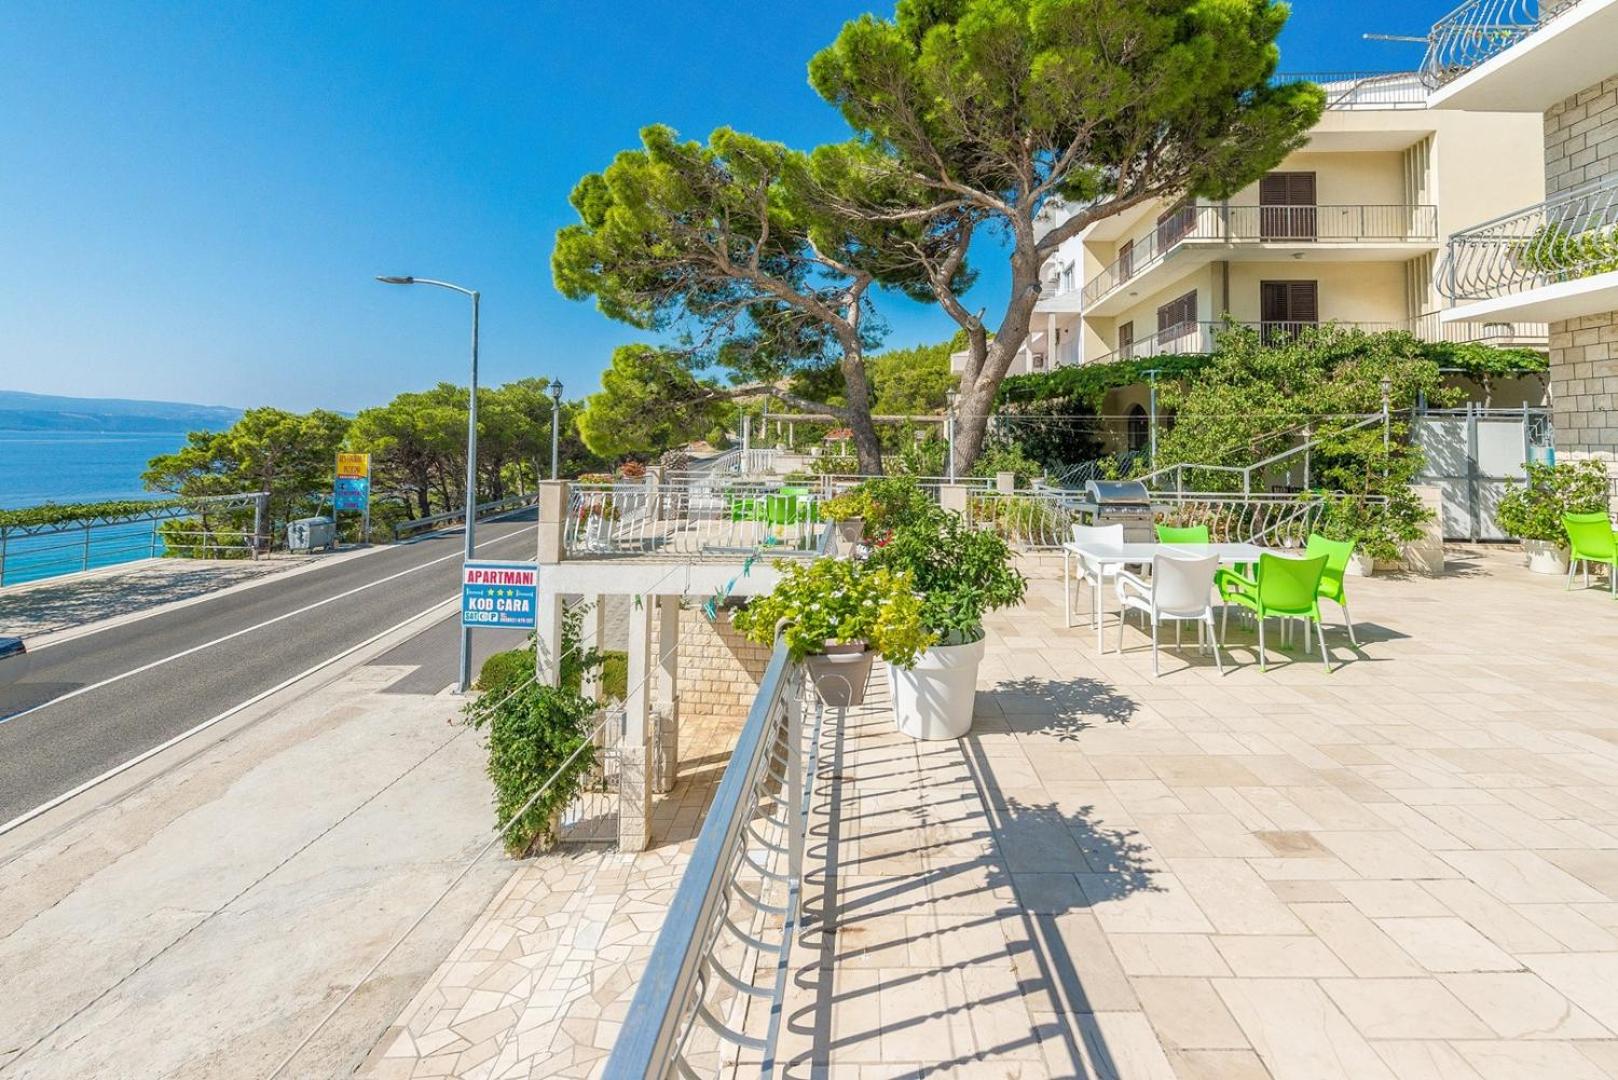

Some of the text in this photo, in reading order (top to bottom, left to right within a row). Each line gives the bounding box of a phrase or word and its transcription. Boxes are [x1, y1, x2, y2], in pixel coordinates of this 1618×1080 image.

[467, 570, 534, 585] APARTMANI
[469, 598, 529, 612] KOD CARA
